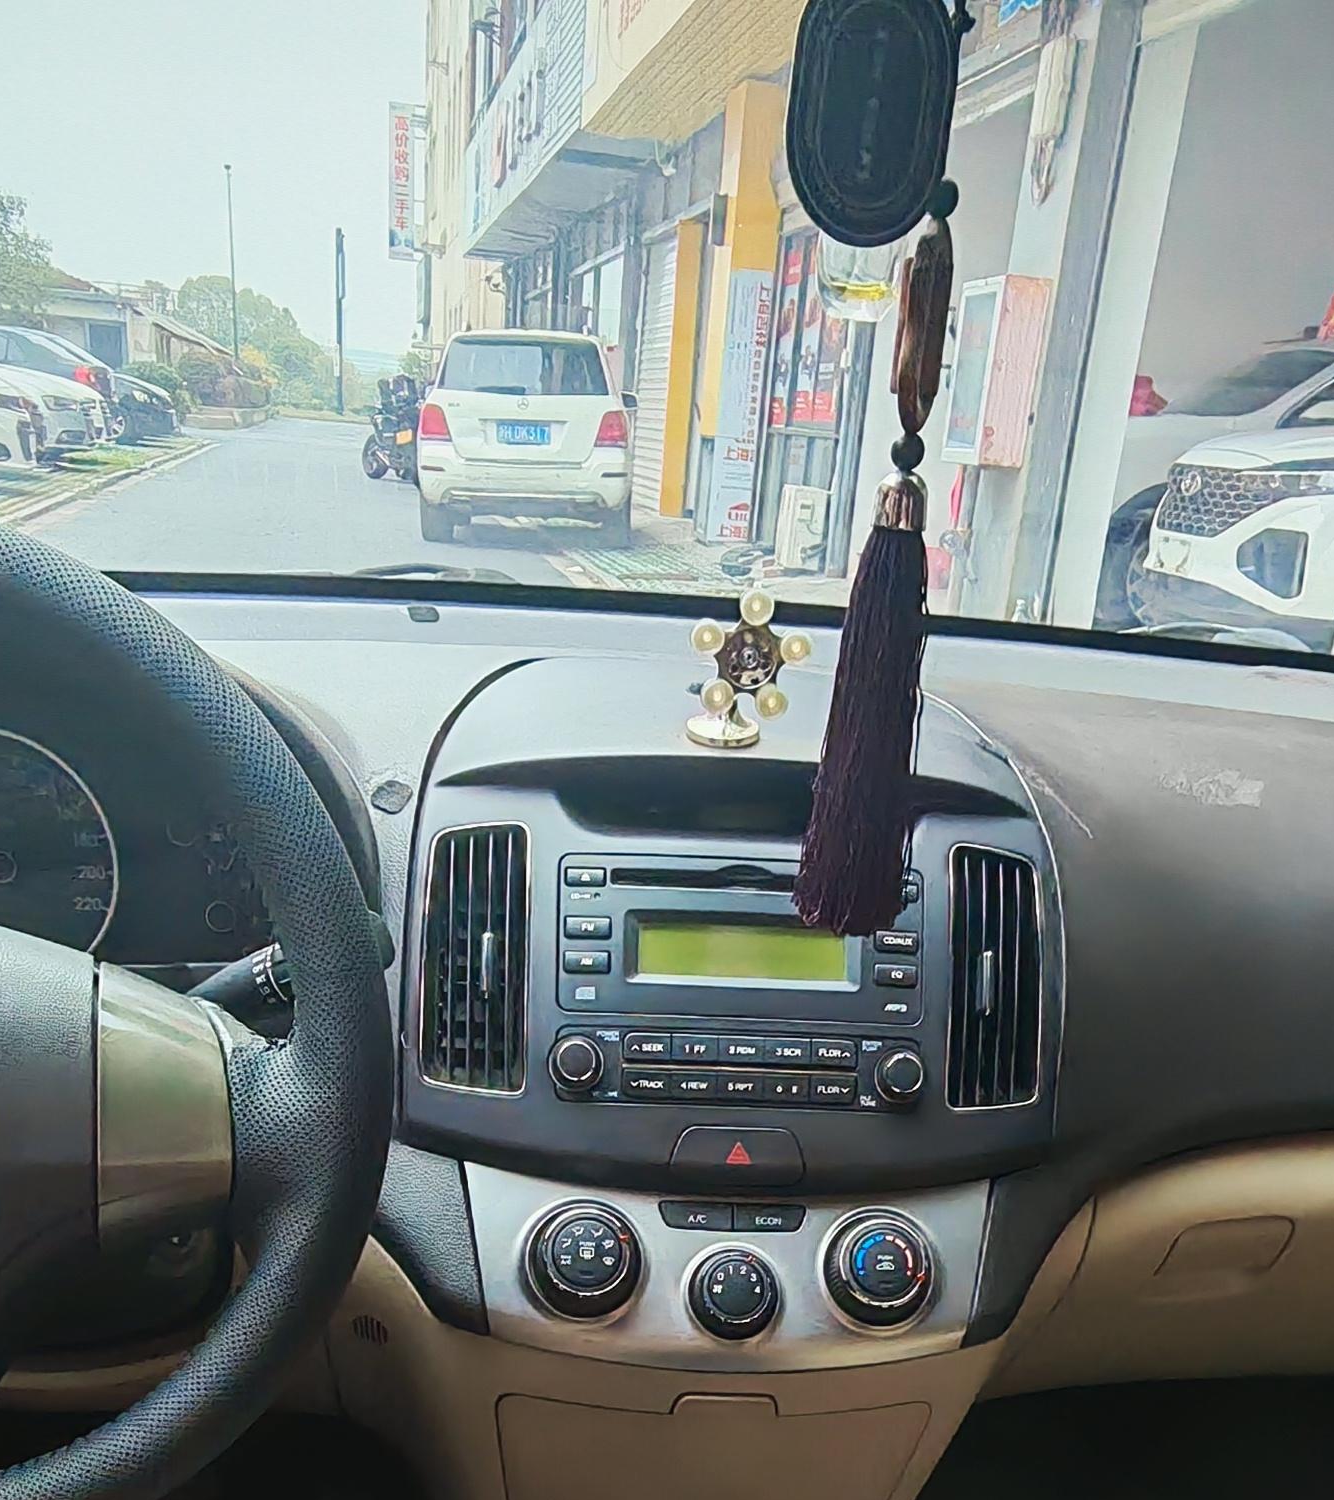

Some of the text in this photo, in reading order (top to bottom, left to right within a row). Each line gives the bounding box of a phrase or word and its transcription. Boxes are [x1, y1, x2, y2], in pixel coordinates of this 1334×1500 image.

[394, 115, 410, 231] 高价收购二手车
[77, 865, 105, 880] 200
[74, 897, 101, 911] 220
[641, 1043, 664, 1052] SEEK
[684, 1045, 706, 1054] 1 FF
[818, 1049, 841, 1058] FLDR
[640, 1080, 664, 1089] TRACK
[680, 1081, 708, 1090] 4 REW
[734, 1083, 754, 1092] RPT
[817, 1086, 840, 1095] FLDR
[687, 1214, 707, 1225] A/C
[755, 1216, 782, 1226] ECON
[728, 1266, 733, 1275] 1
[740, 1266, 747, 1275] 2
[750, 1273, 757, 1282] 3
[754, 1284, 761, 1294] 4
